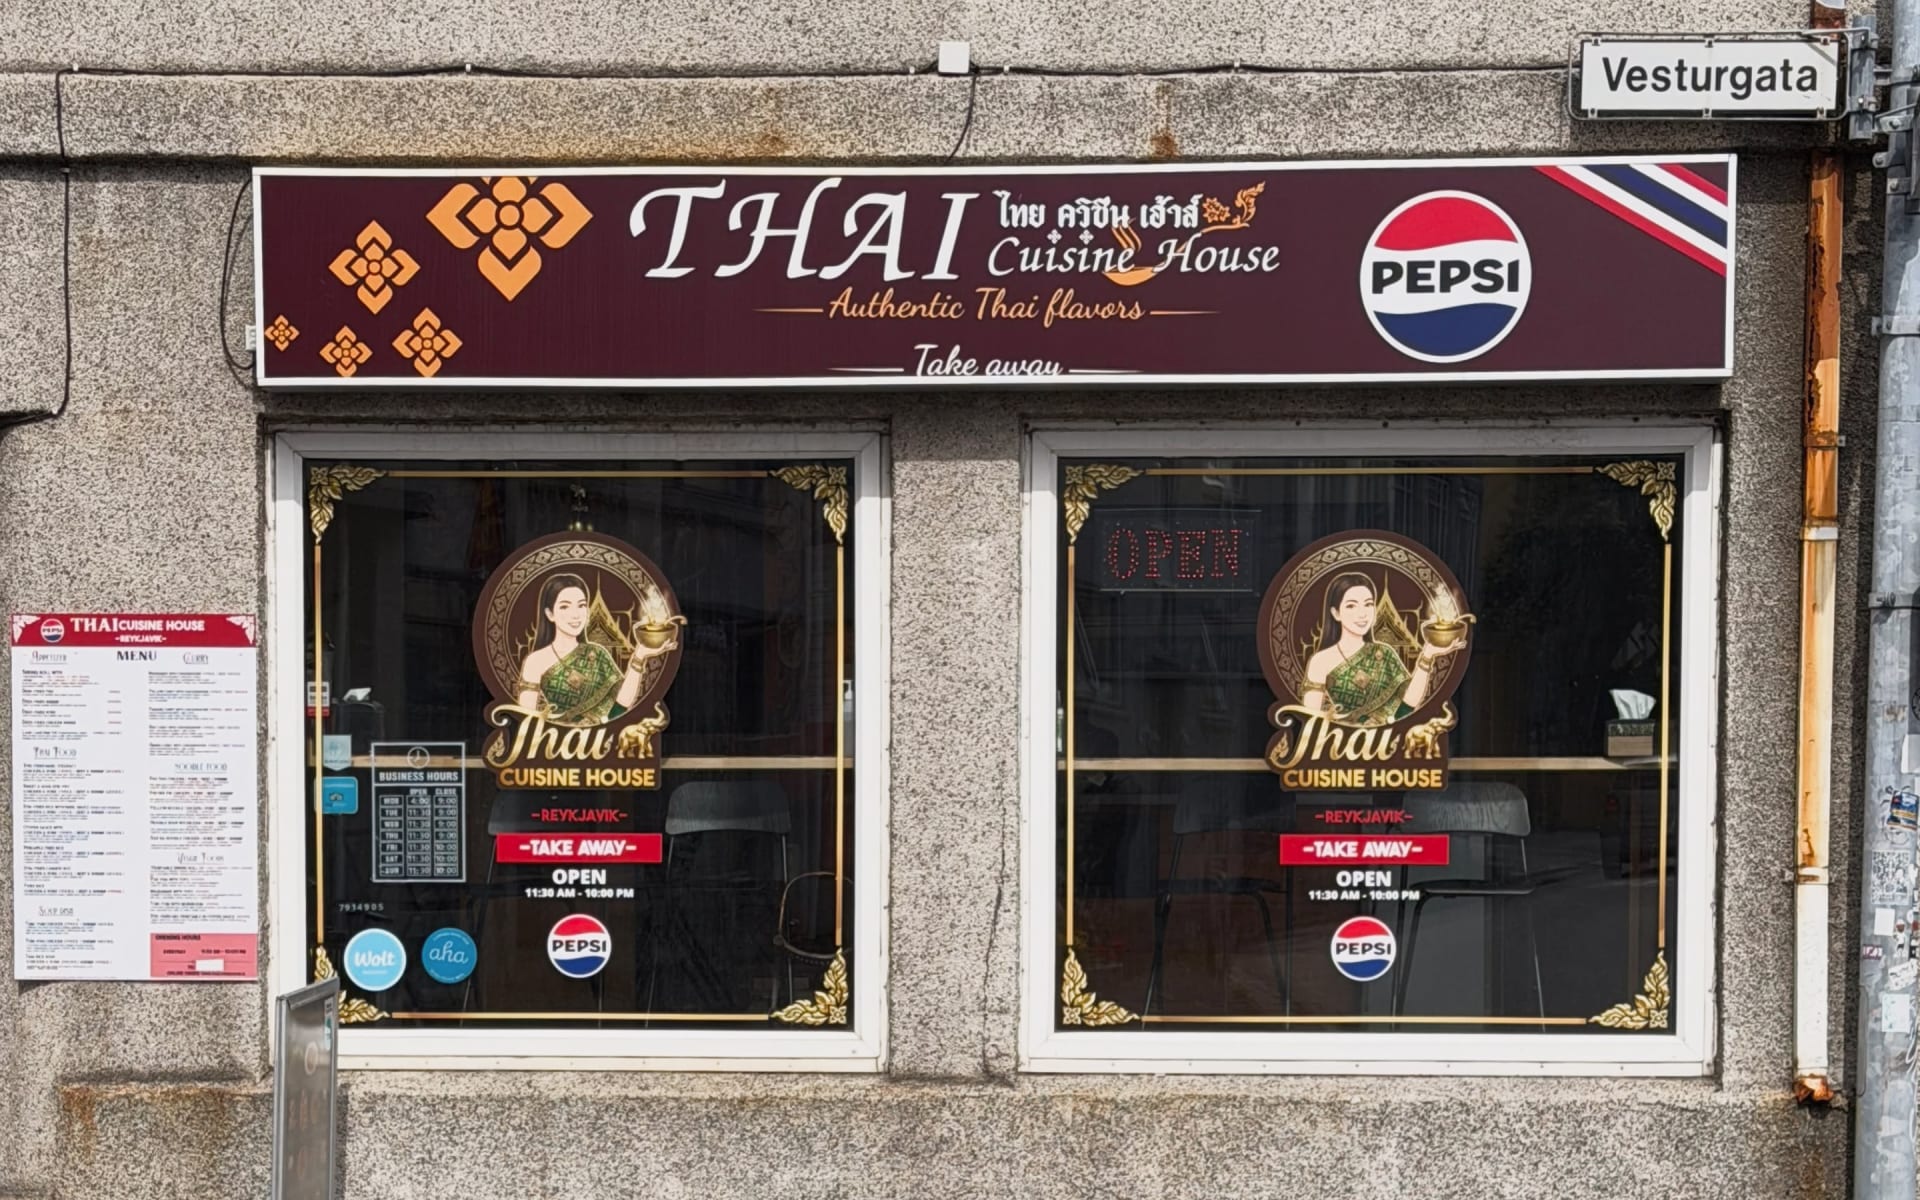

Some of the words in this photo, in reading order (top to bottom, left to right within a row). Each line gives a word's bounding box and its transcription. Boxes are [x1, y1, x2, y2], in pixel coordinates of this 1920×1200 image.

[1602, 57, 1818, 99] Vesturgata
[992, 189, 1046, 228] ไทย
[629, 177, 980, 282] THAI
[988, 229, 1136, 276] Cuisine
[1154, 232, 1280, 273] House
[1372, 258, 1520, 294] PEPSI
[829, 286, 965, 320] Authentic
[975, 286, 1038, 320] Thai
[1044, 286, 1146, 328] flavors
[914, 343, 979, 376] Take
[985, 358, 1063, 377] away
[1103, 528, 1243, 579] OPEN
[70, 617, 118, 632] THAI
[118, 619, 164, 631] CUISINE
[165, 619, 205, 631] HOUSE
[116, 650, 157, 661] MENU
[488, 704, 613, 768] Thai
[1269, 704, 1400, 769] Thai
[379, 771, 425, 781] BUSINESS
[427, 771, 459, 781] HOURS
[500, 768, 581, 787] CUISINE
[586, 768, 655, 787] HOUSE
[1283, 769, 1365, 788] CUISINE
[1371, 769, 1442, 788] HOUSE
[552, 868, 607, 885] OPEN
[1336, 870, 1392, 888] OPEN
[525, 888, 554, 898] 11:30
[556, 888, 576, 898] AM
[585, 888, 613, 898] 10:00
[616, 888, 635, 898] PM
[1308, 890, 1338, 901] 11:30
[1340, 890, 1360, 901] AM
[1369, 890, 1399, 901] 10:00
[1401, 890, 1420, 901] PM
[429, 940, 469, 964] aha
[552, 939, 607, 953] PEPSI
[1335, 942, 1392, 956] PEPSI
[354, 950, 396, 968] Wolt
